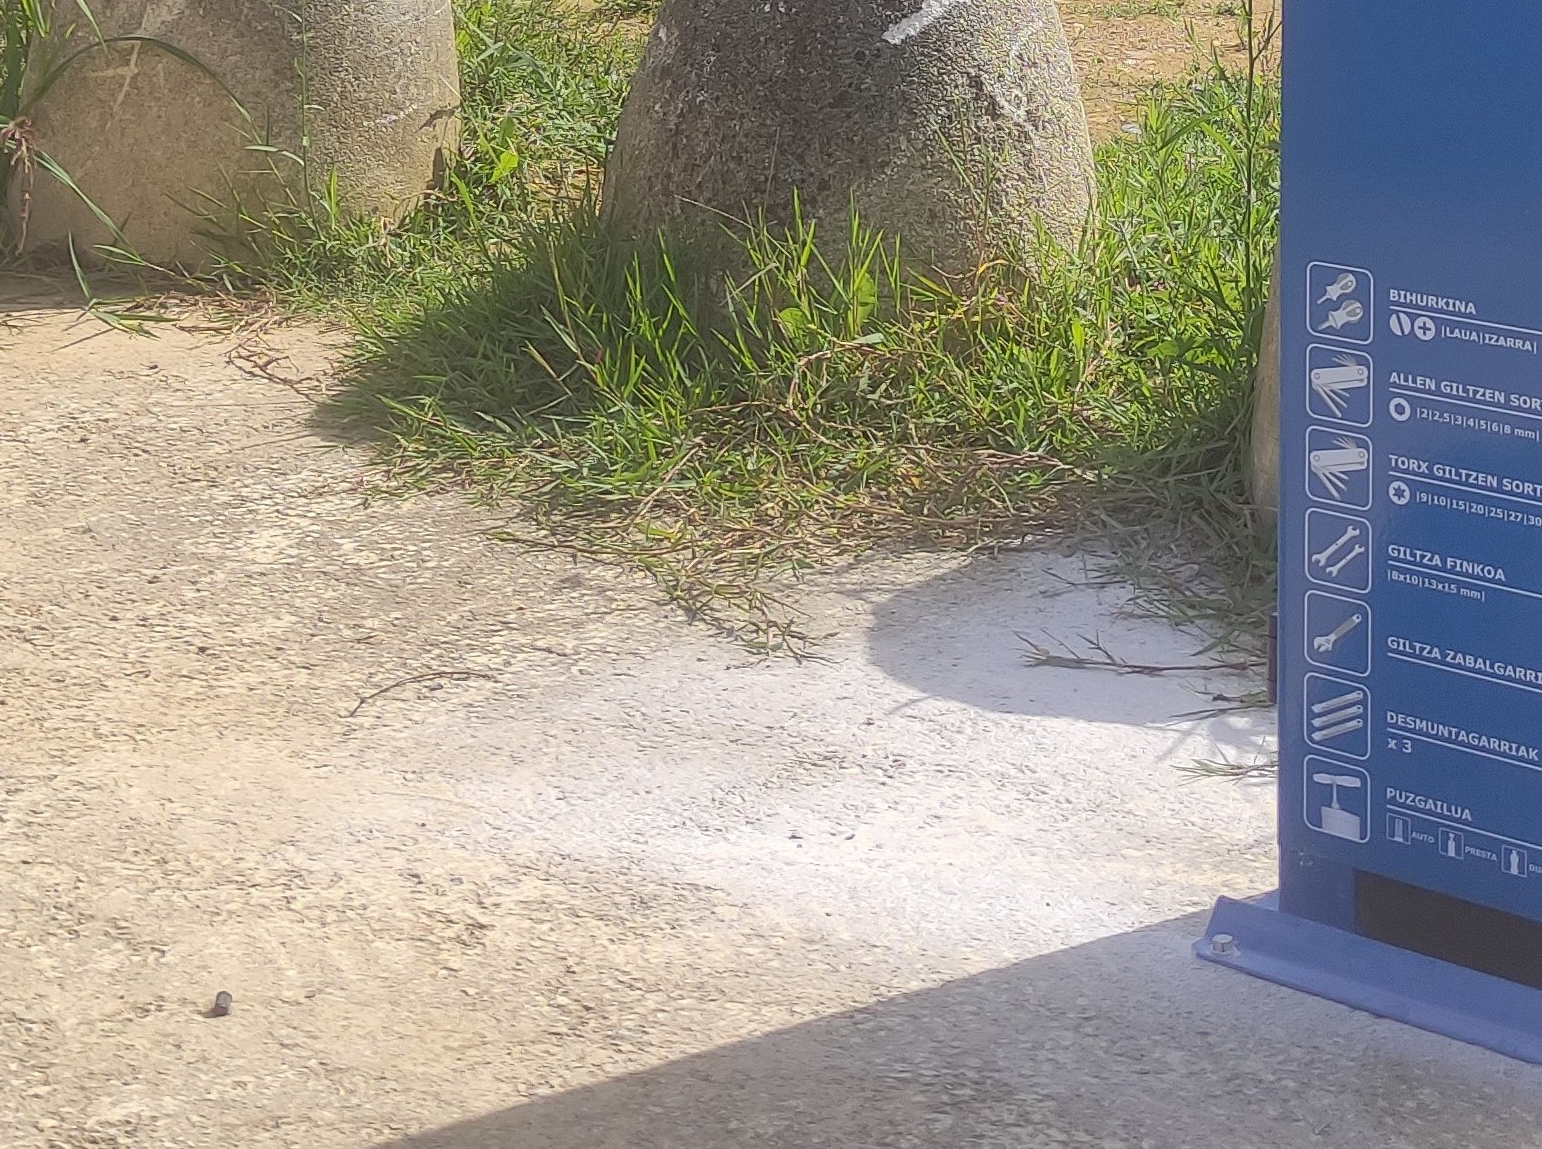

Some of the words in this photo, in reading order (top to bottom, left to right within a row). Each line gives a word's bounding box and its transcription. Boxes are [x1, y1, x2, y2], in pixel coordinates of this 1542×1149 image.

[1389, 288, 1477, 315] BIHURKINA
[1389, 371, 1436, 391] ALLEN
[1440, 381, 1505, 404] GILTZEN
[1388, 454, 1429, 474] TORX
[1433, 463, 1498, 488] GILTZEN
[1388, 544, 1442, 568] GILTZA
[1446, 556, 1506, 582] FINKOA
[1387, 636, 1442, 660] GILTZA
[1386, 711, 1540, 762] DESMUNTAGARRIAK
[1387, 737, 1398, 750] x
[1401, 739, 1412, 753] 3
[1386, 787, 1473, 822] PUZGAILUA
[1411, 831, 1435, 844] AUTO
[1464, 846, 1498, 863] PRESTA
